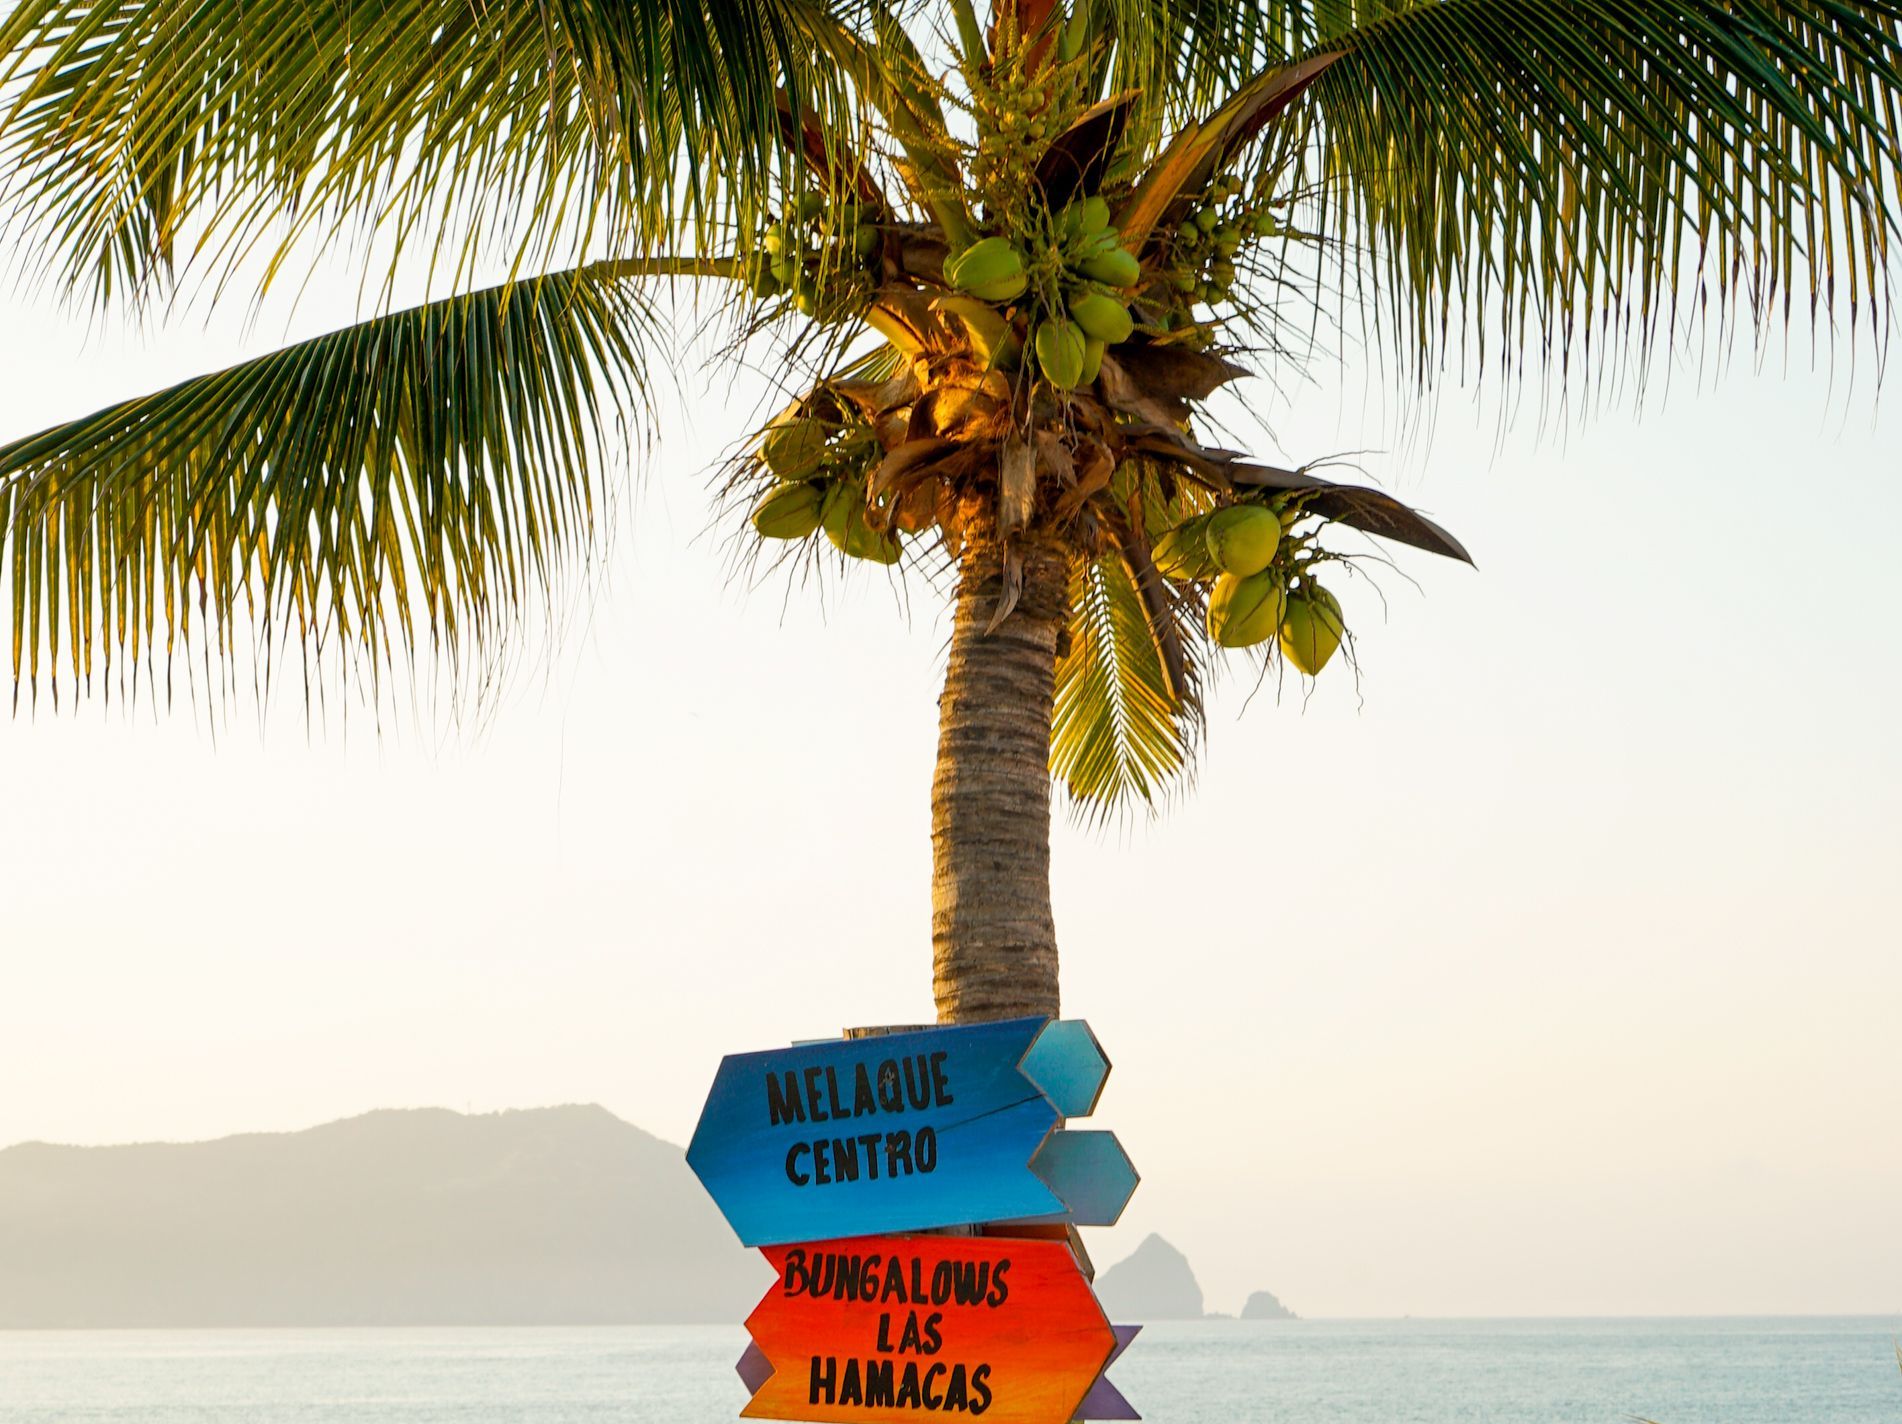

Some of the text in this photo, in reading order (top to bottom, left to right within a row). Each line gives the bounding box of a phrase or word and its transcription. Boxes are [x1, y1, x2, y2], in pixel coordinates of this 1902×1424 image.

[766, 1051, 954, 1126] MELAQUE
[785, 1126, 937, 1187] CENTRO
[784, 1249, 1011, 1307] BUNGALOWS
[876, 1311, 943, 1355] LAS
[808, 1356, 993, 1415] HAMACAS
